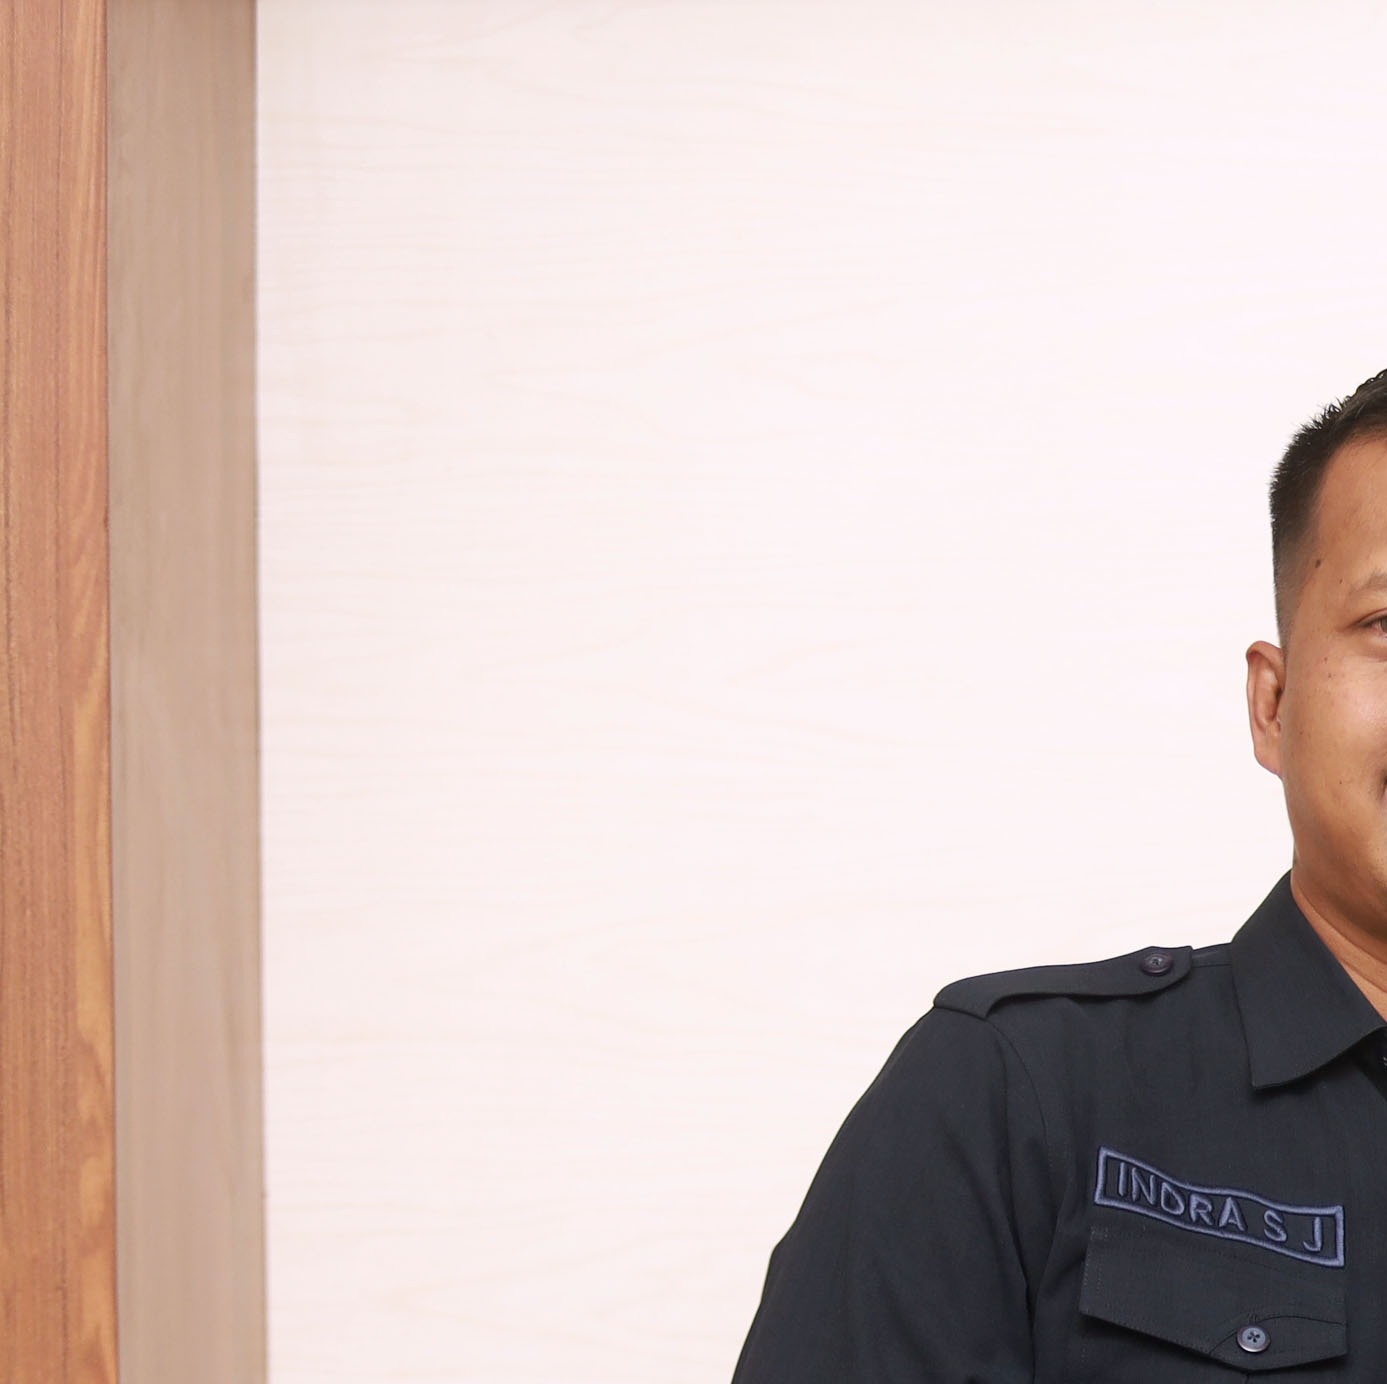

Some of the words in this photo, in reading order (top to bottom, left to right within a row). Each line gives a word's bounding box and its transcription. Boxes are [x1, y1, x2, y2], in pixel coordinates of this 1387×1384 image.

[1118, 1162, 1247, 1231] INDRA
[1264, 1209, 1287, 1242] S
[1303, 1216, 1322, 1251] J
